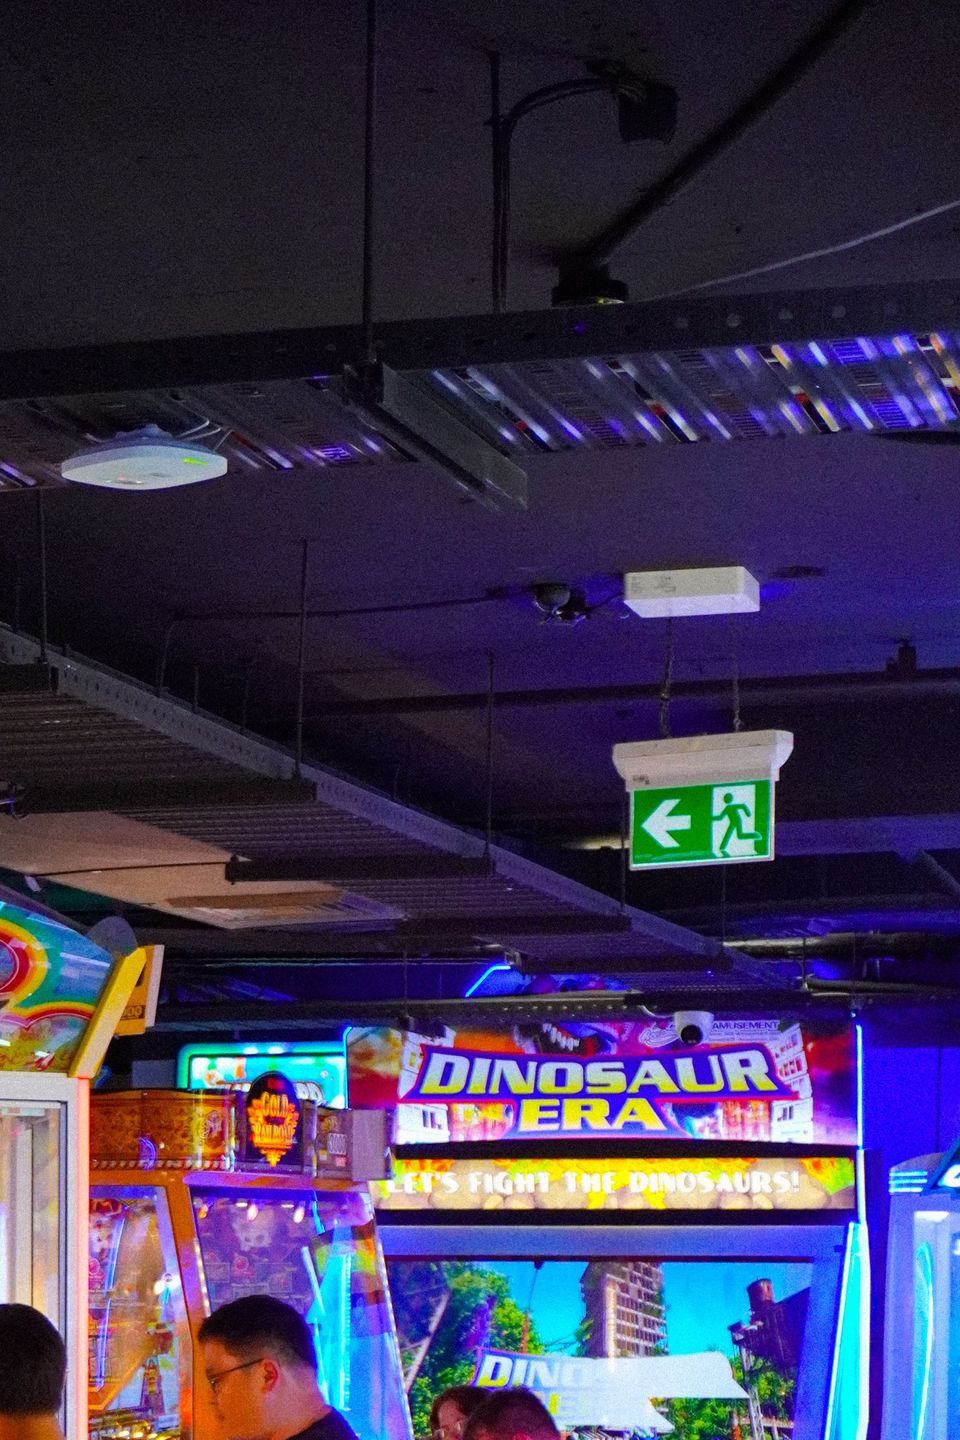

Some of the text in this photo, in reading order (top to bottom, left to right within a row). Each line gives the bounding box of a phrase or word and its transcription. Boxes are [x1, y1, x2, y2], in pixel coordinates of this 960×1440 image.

[711, 1021, 779, 1030] AMUSEMENT
[419, 1048, 779, 1096] DINOSAUR
[261, 1091, 290, 1116] GOLD
[518, 1098, 668, 1133] ERA
[386, 1170, 802, 1195] LET'S FIGHT THE DINOSAURS!
